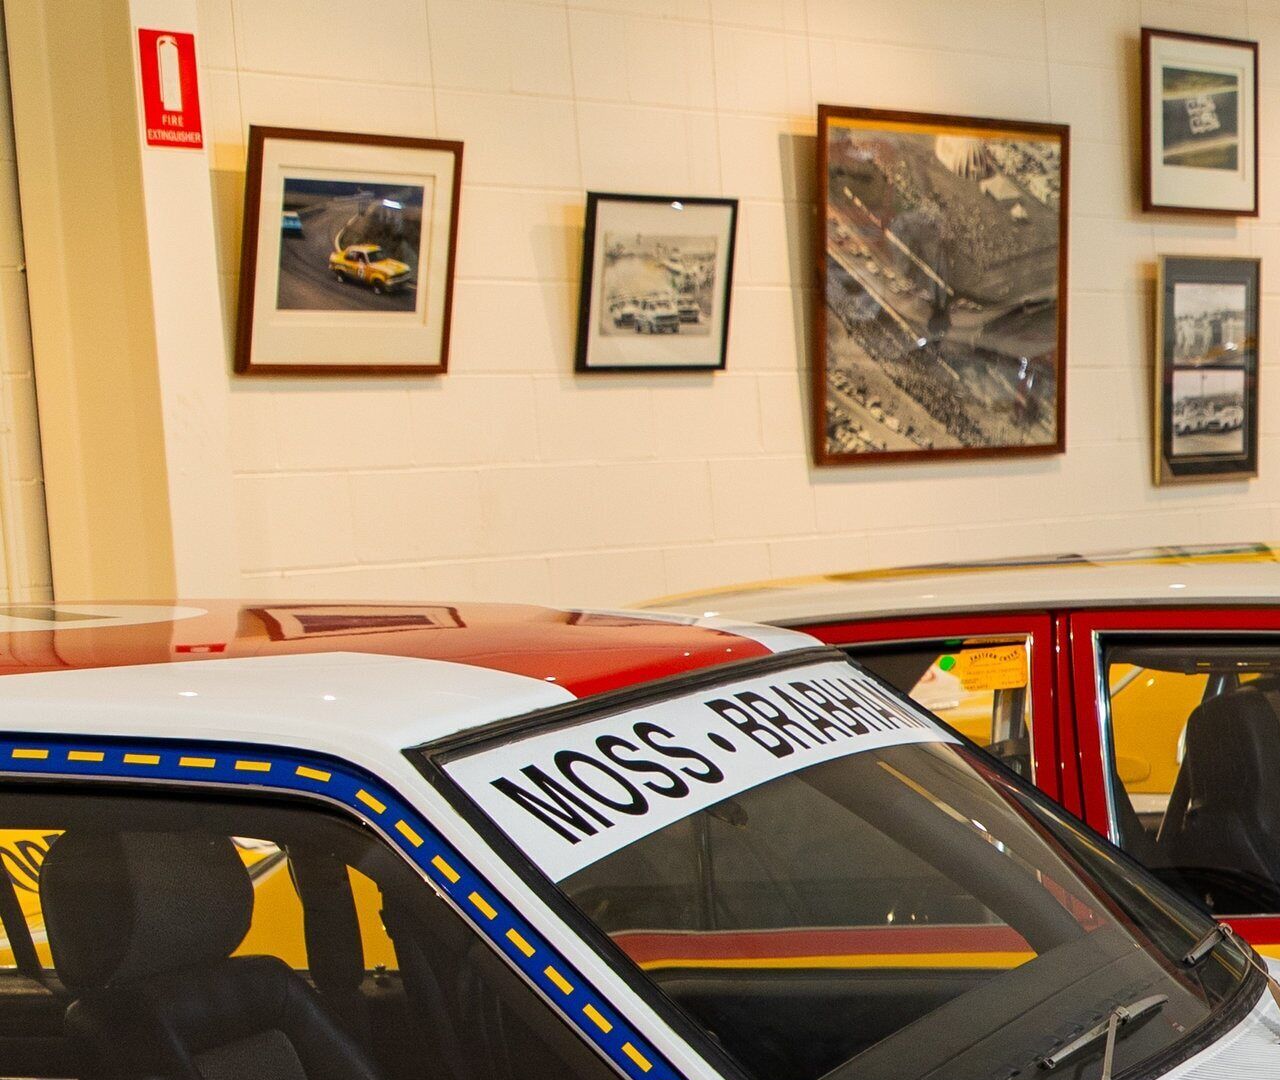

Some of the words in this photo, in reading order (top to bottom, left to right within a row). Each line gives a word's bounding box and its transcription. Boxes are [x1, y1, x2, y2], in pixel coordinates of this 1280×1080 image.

[162, 114, 184, 127] FIRE
[148, 129, 202, 143] EXTINGUISHER
[489, 721, 724, 845] MOSS
[704, 678, 931, 759] BRABHAM
